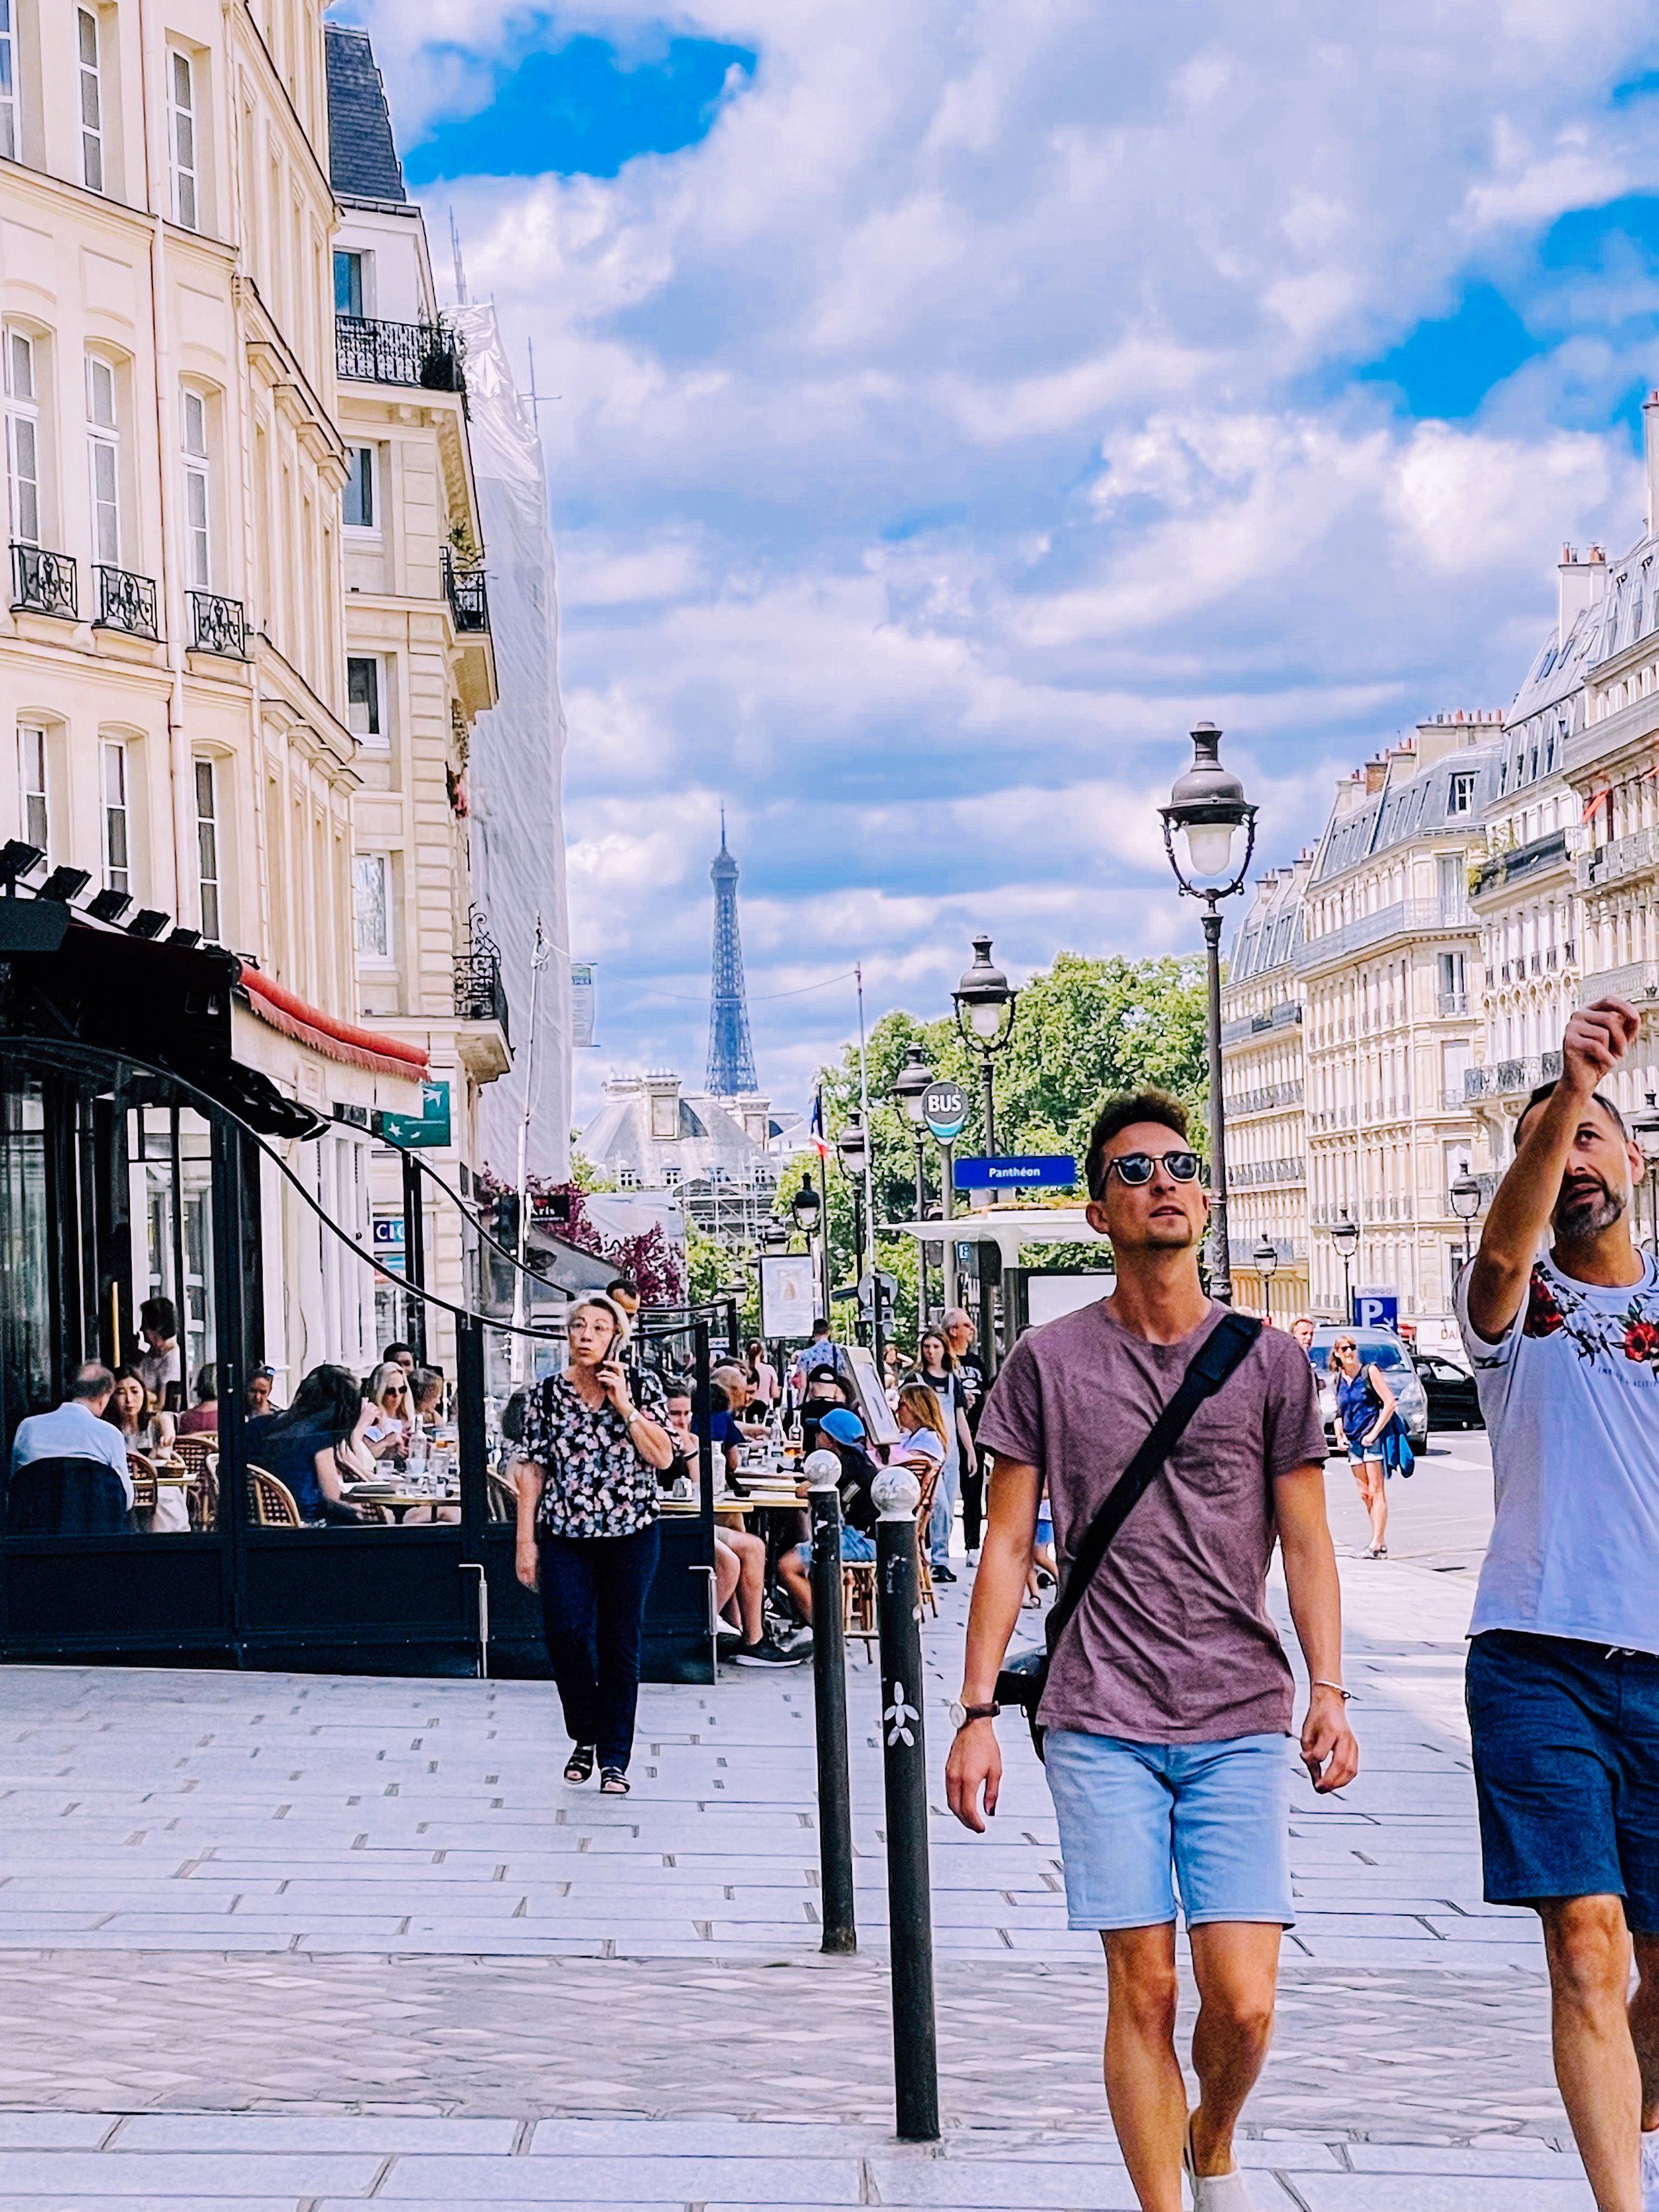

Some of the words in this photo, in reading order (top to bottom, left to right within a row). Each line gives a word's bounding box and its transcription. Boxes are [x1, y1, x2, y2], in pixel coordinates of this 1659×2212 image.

[928, 1094, 962, 1113] BUS
[989, 1166, 1041, 1178] Panthéon
[1361, 1299, 1384, 1328] P
